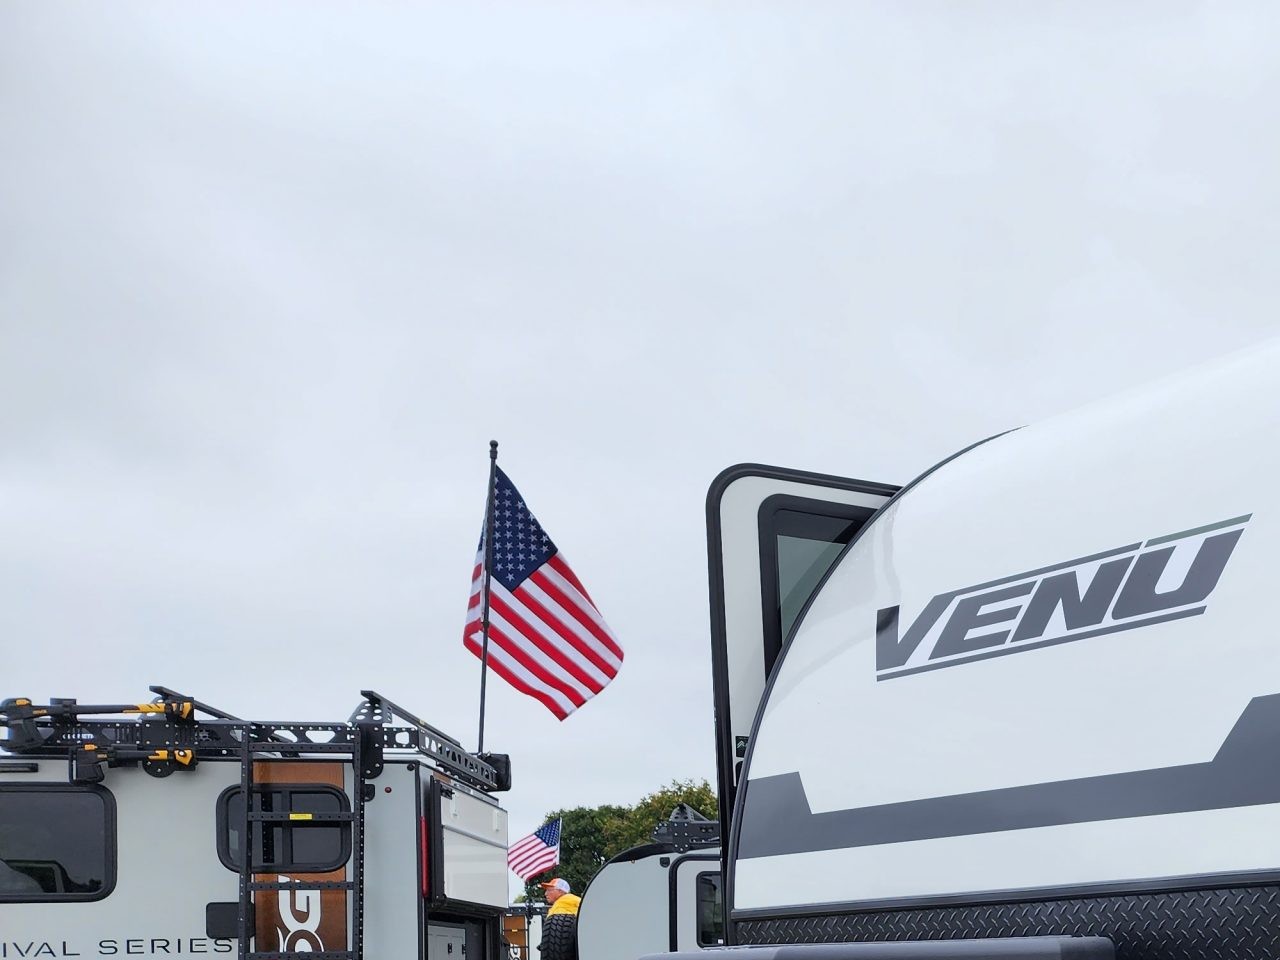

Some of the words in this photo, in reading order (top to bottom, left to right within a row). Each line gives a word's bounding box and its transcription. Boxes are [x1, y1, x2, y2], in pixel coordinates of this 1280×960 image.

[876, 516, 1250, 676] VENU
[3, 941, 81, 957] IVAL
[98, 937, 233, 955] SERIES
